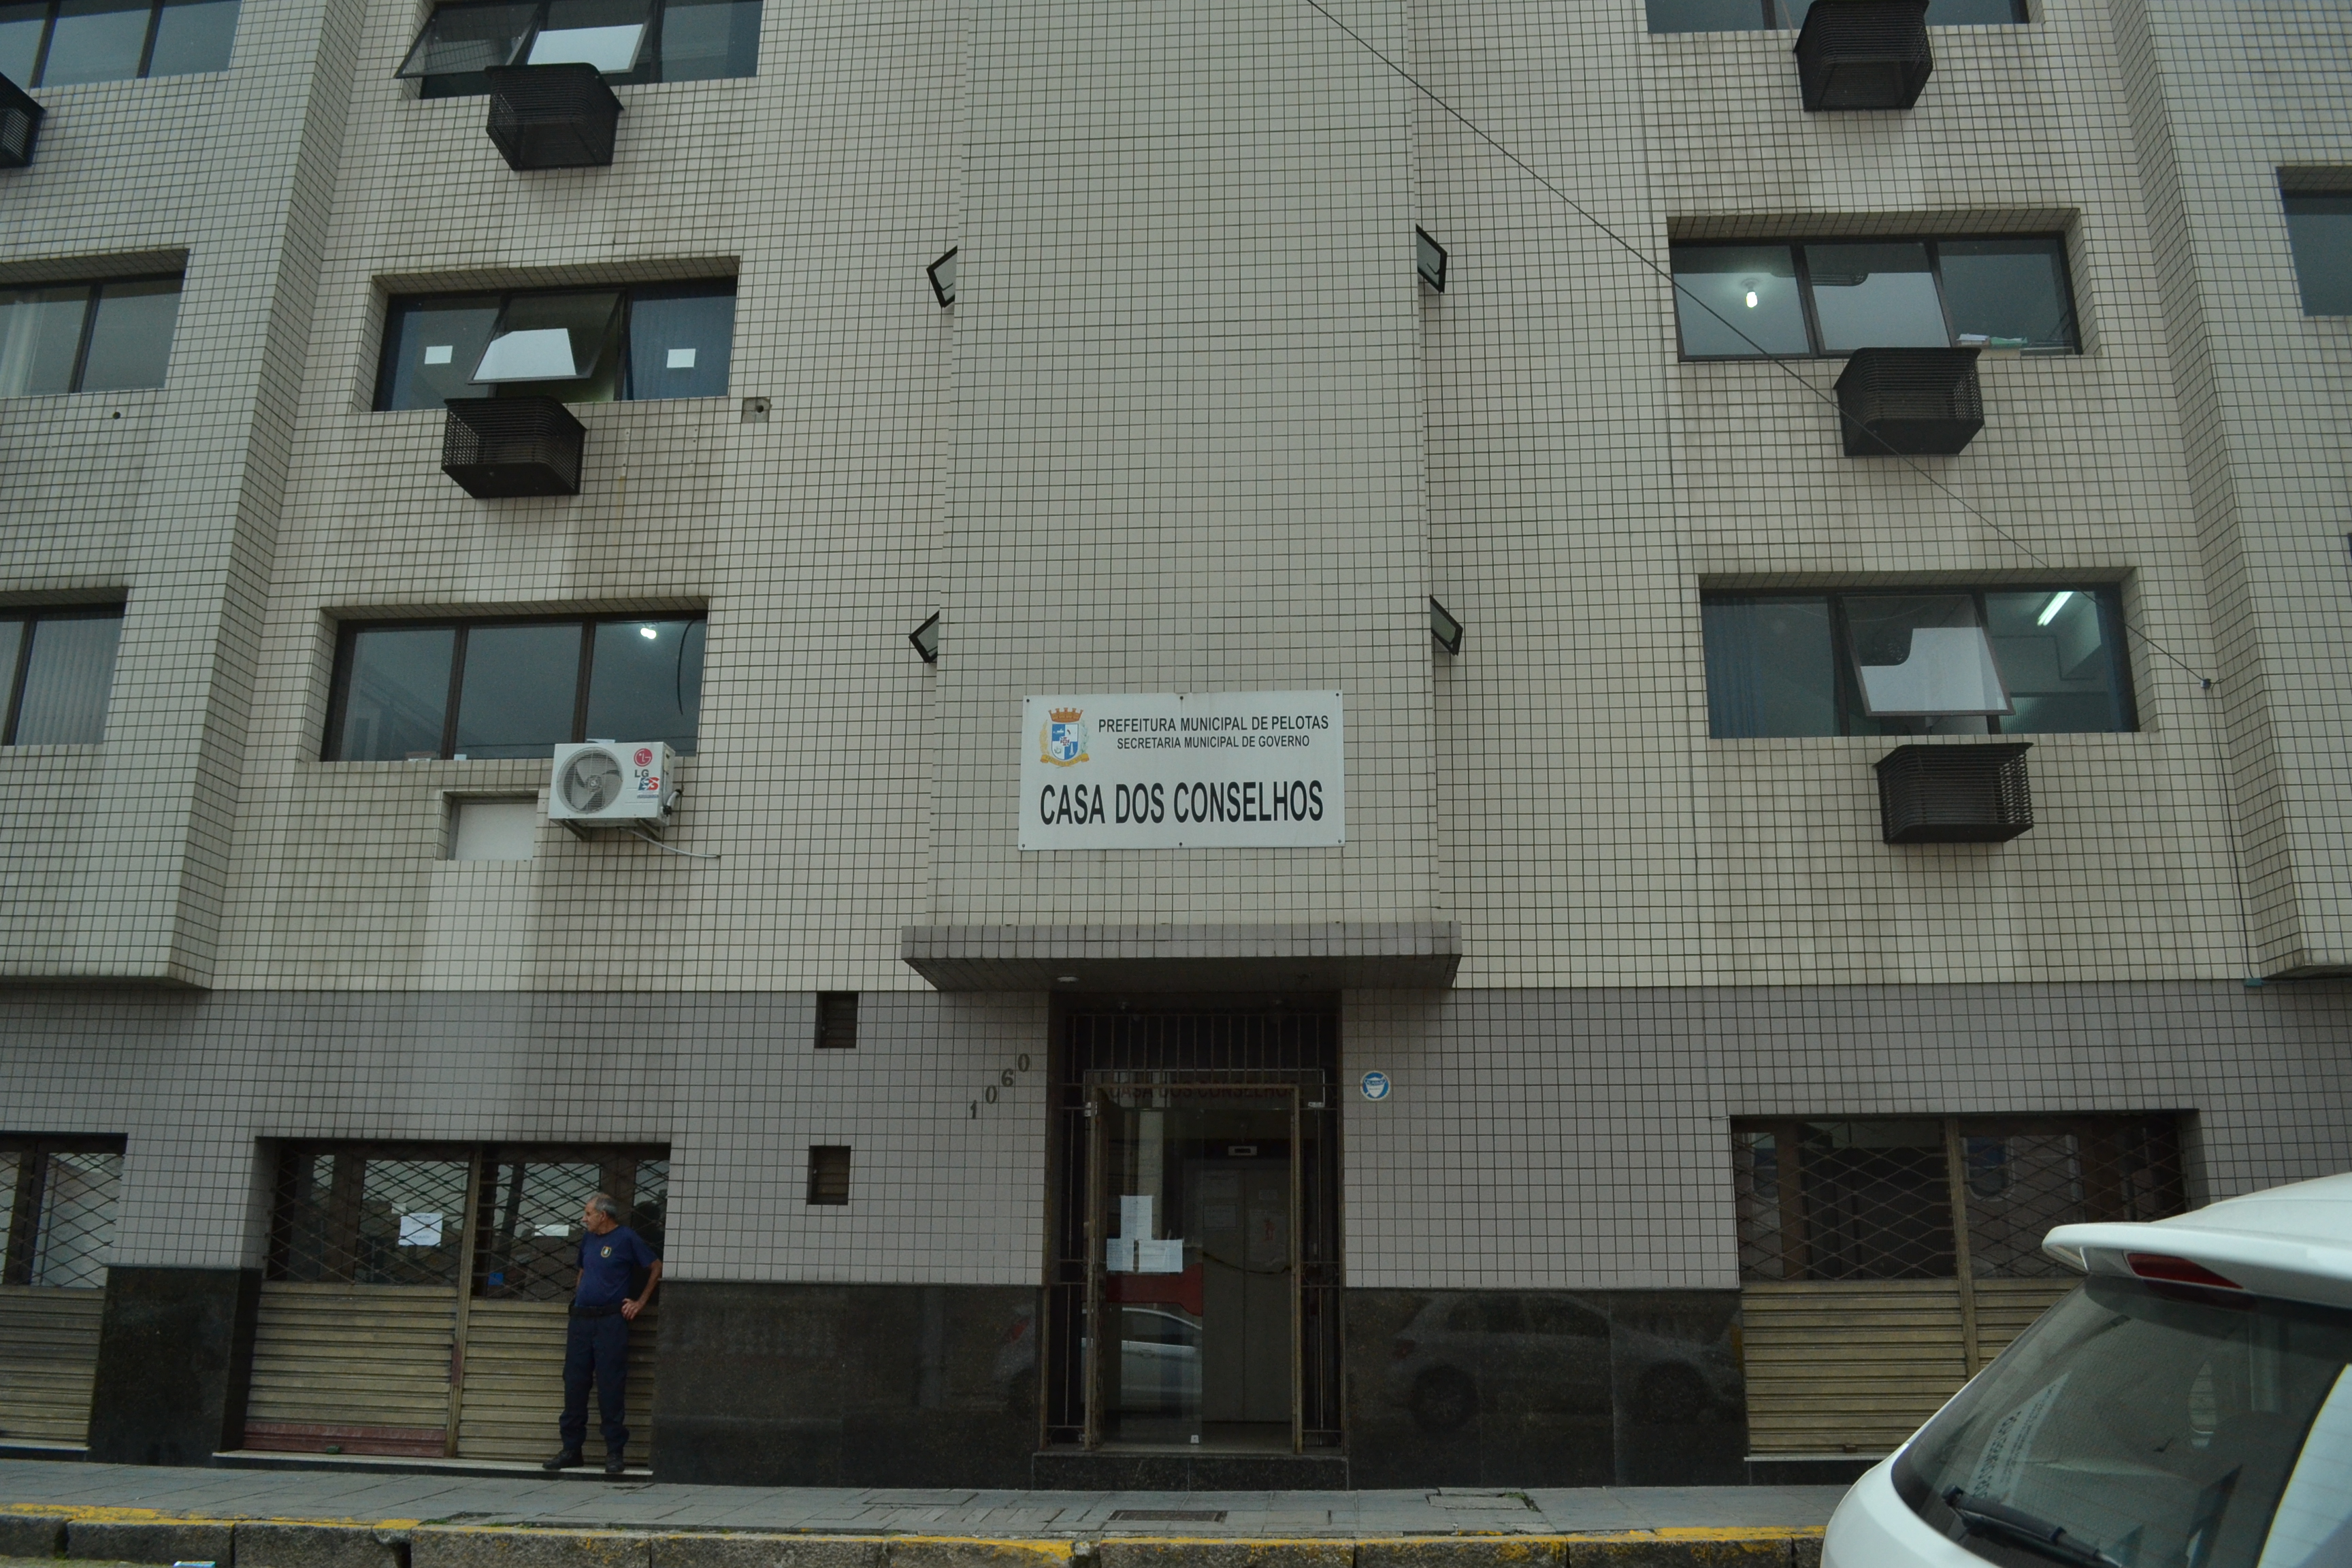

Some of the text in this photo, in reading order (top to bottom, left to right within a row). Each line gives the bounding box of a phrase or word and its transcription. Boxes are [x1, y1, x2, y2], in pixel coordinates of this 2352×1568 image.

[1098, 715, 1328, 732] PREFEITURA MUNICIPAL DE PELOTAS
[1117, 734, 1310, 749] SECRETARIA MUNICIPAL DE GOVERNO
[635, 769, 649, 777] LG
[1040, 780, 1324, 825] CASA DOS CONSELHOS
[970, 1053, 1030, 1119] 1060
